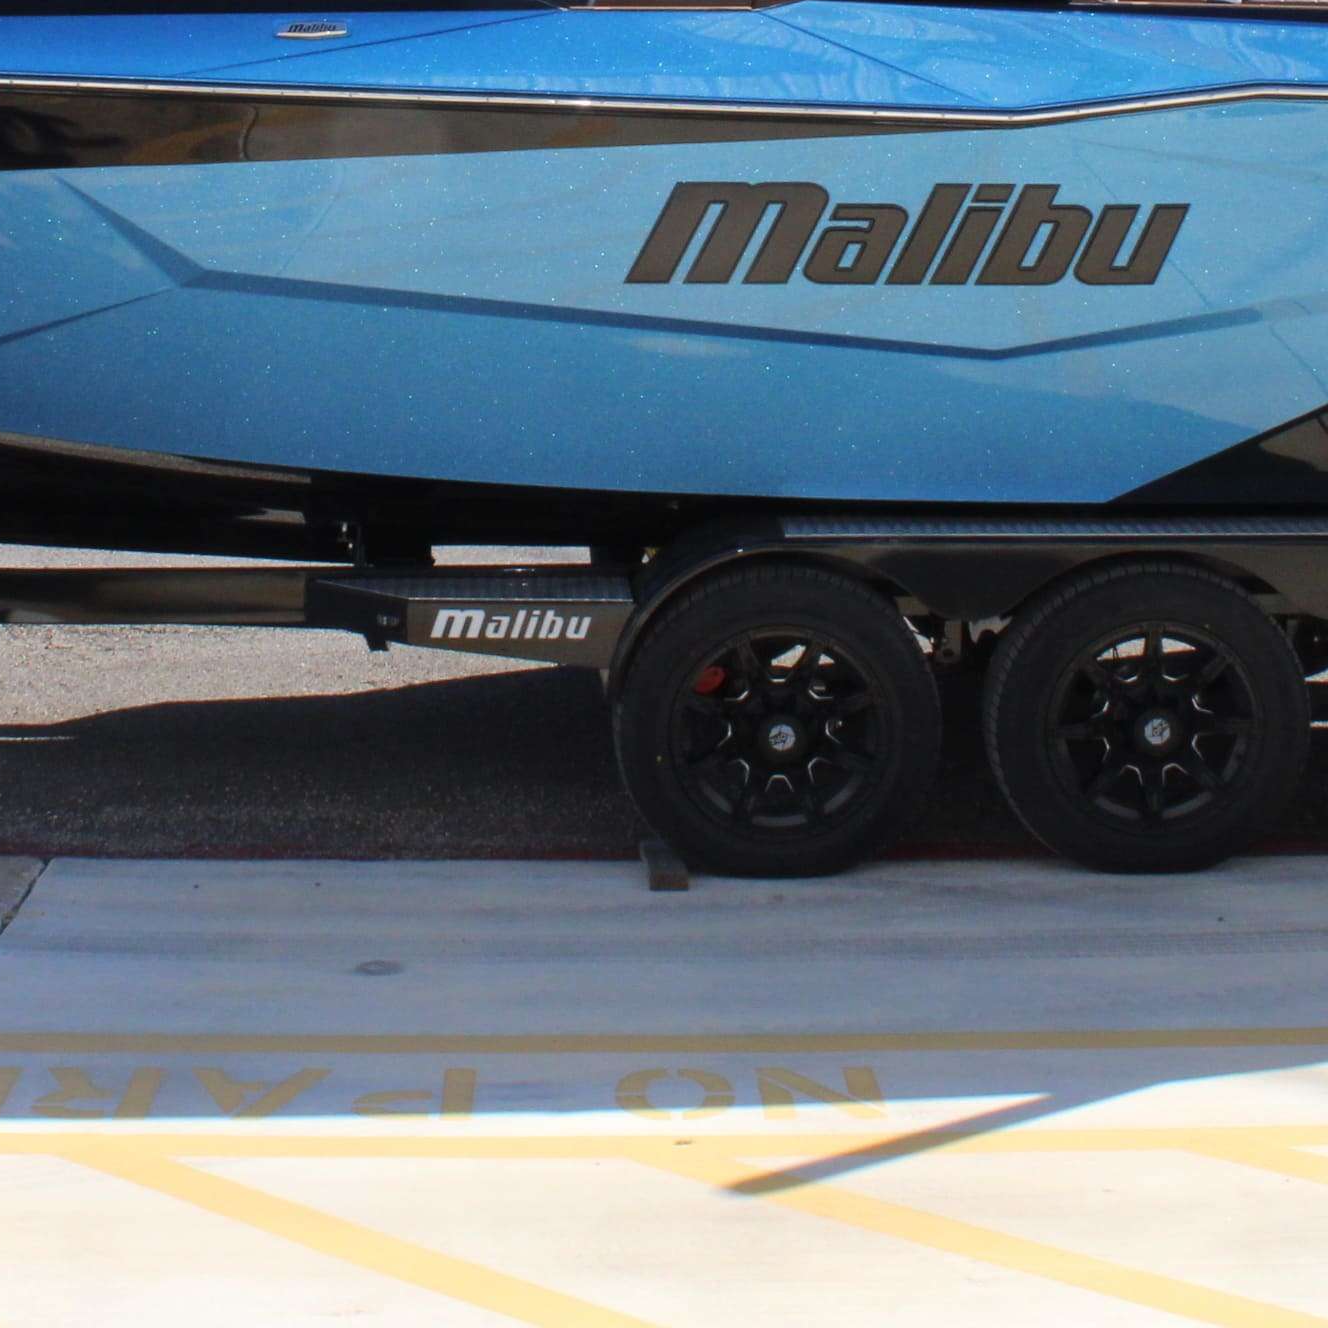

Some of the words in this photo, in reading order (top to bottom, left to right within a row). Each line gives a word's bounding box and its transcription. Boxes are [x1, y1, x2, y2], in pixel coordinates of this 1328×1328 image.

[288, 22, 337, 33] Malibu
[625, 181, 1191, 286] Malibu
[430, 608, 592, 640] Malibu
[613, 1067, 889, 1121] NO
